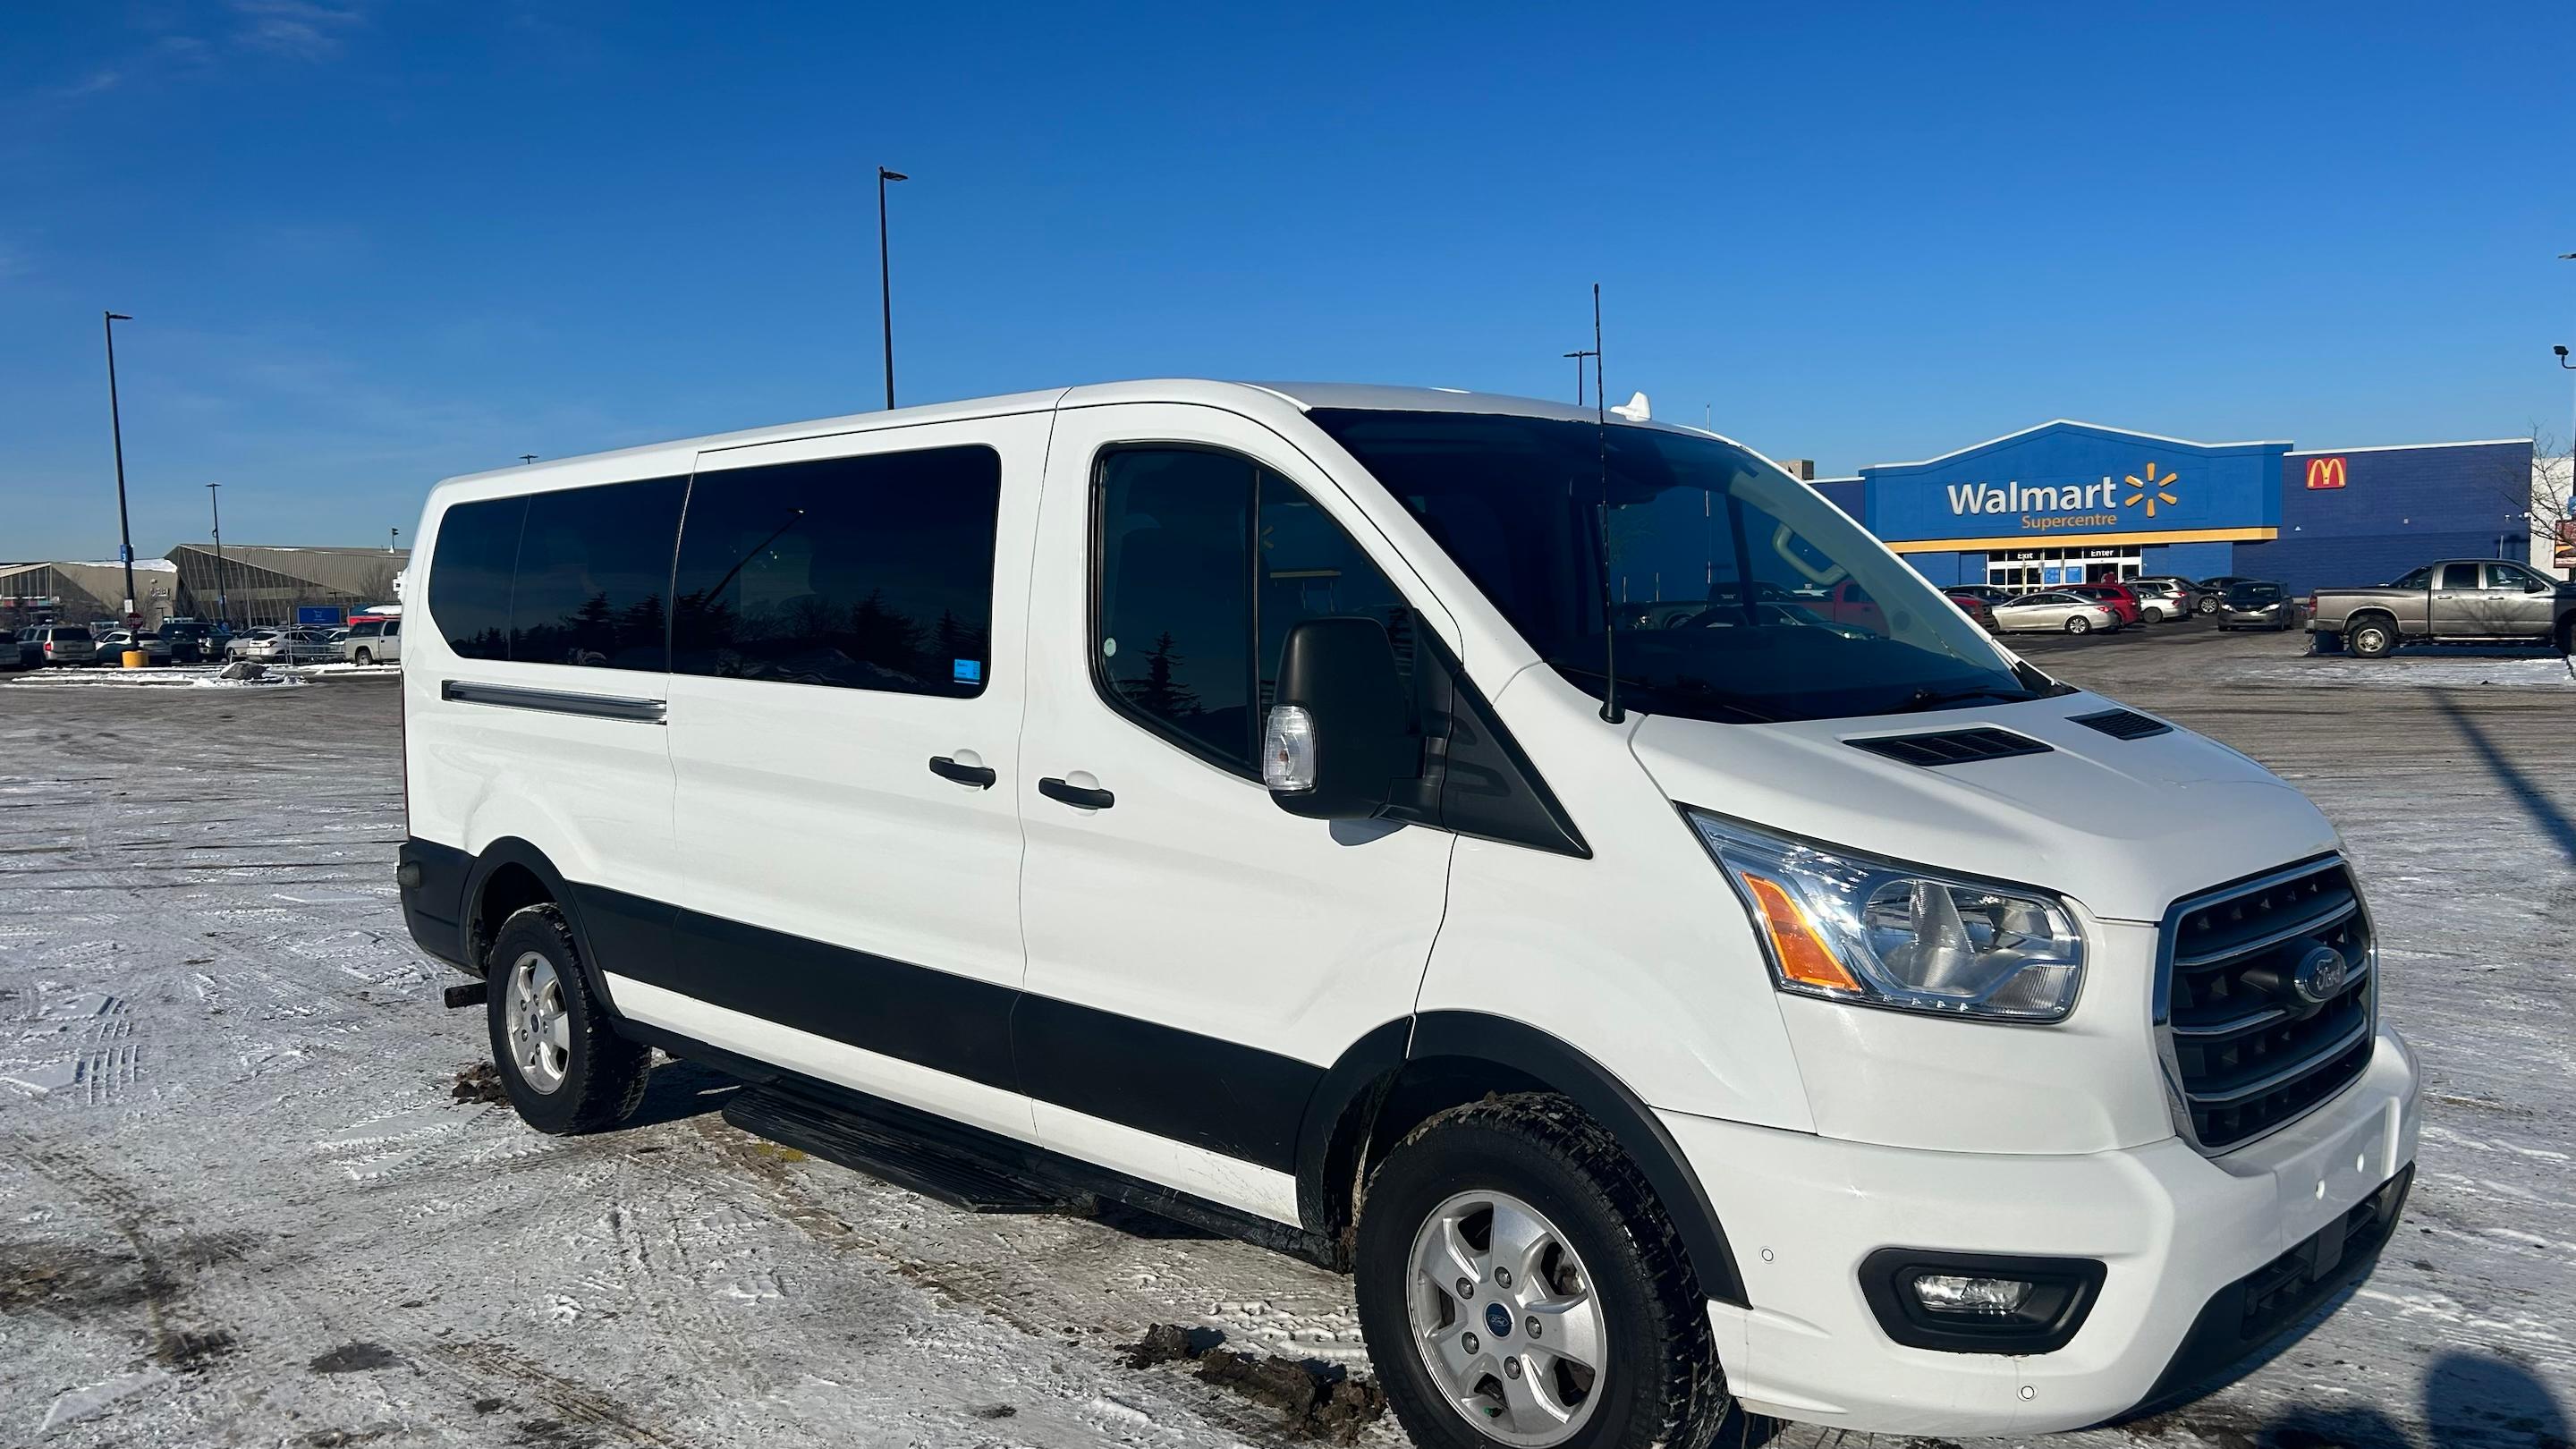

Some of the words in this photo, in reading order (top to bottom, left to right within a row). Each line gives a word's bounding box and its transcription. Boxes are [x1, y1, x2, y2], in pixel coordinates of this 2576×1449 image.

[1947, 476, 2117, 515] Walmart
[2021, 513, 2117, 530] Supercentre
[2317, 959, 2341, 991] Ford
